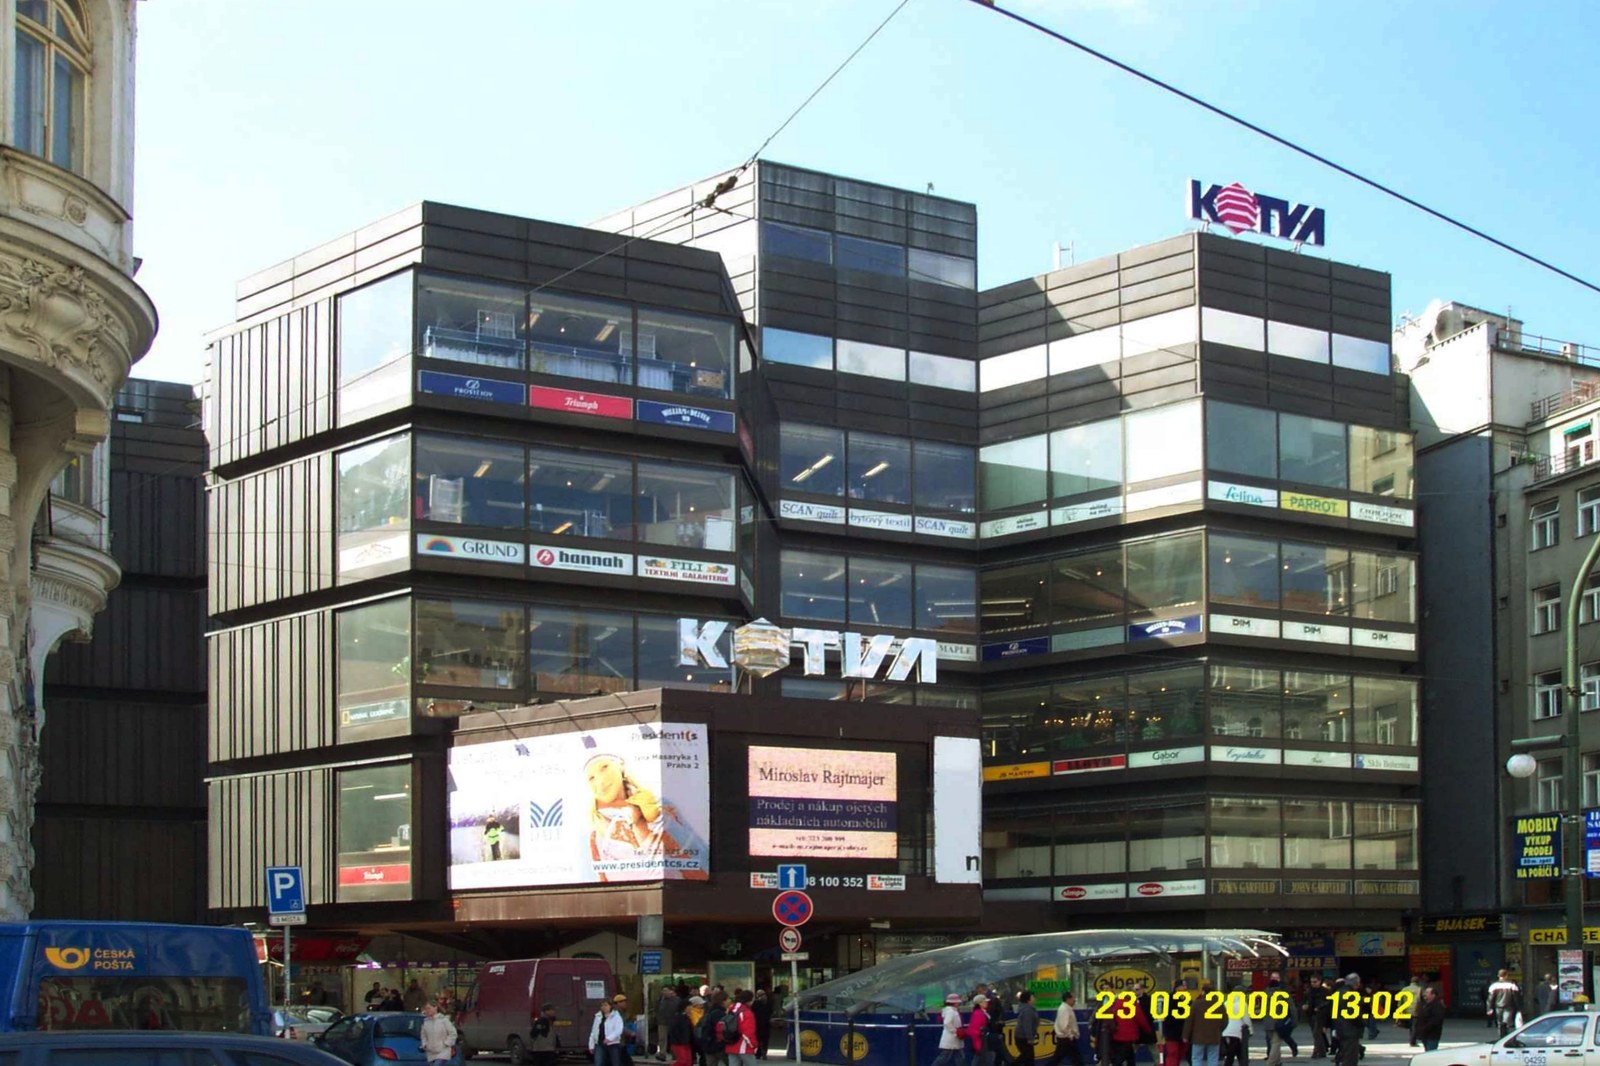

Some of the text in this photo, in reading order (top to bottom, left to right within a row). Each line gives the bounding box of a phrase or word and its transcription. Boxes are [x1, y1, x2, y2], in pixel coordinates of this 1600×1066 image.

[781, 503, 815, 516] SCAN
[1290, 496, 1338, 514] PARROT
[916, 520, 947, 532] SCAN
[462, 540, 518, 557] GRUND
[558, 550, 624, 568] hannah
[670, 560, 703, 572] FILI
[1303, 625, 1321, 635] DIM
[1152, 751, 1180, 761] Gabor
[759, 767, 885, 788] Miroslav Rajtmajer
[757, 799, 888, 815] Prodej a nákup ojetých
[756, 815, 820, 827] nákladních
[1517, 817, 1559, 834] MOBILY
[1525, 834, 1552, 846] VÝKUP
[1523, 846, 1553, 857] PRODEJ
[593, 859, 699, 871] www.presidentcs.cz
[274, 872, 295, 899] P
[820, 876, 840, 887] 100
[842, 877, 863, 887] 352
[94, 947, 135, 959] ČESKÁ
[94, 959, 135, 970] POŠTA
[1286, 957, 1321, 968] PIZZA
